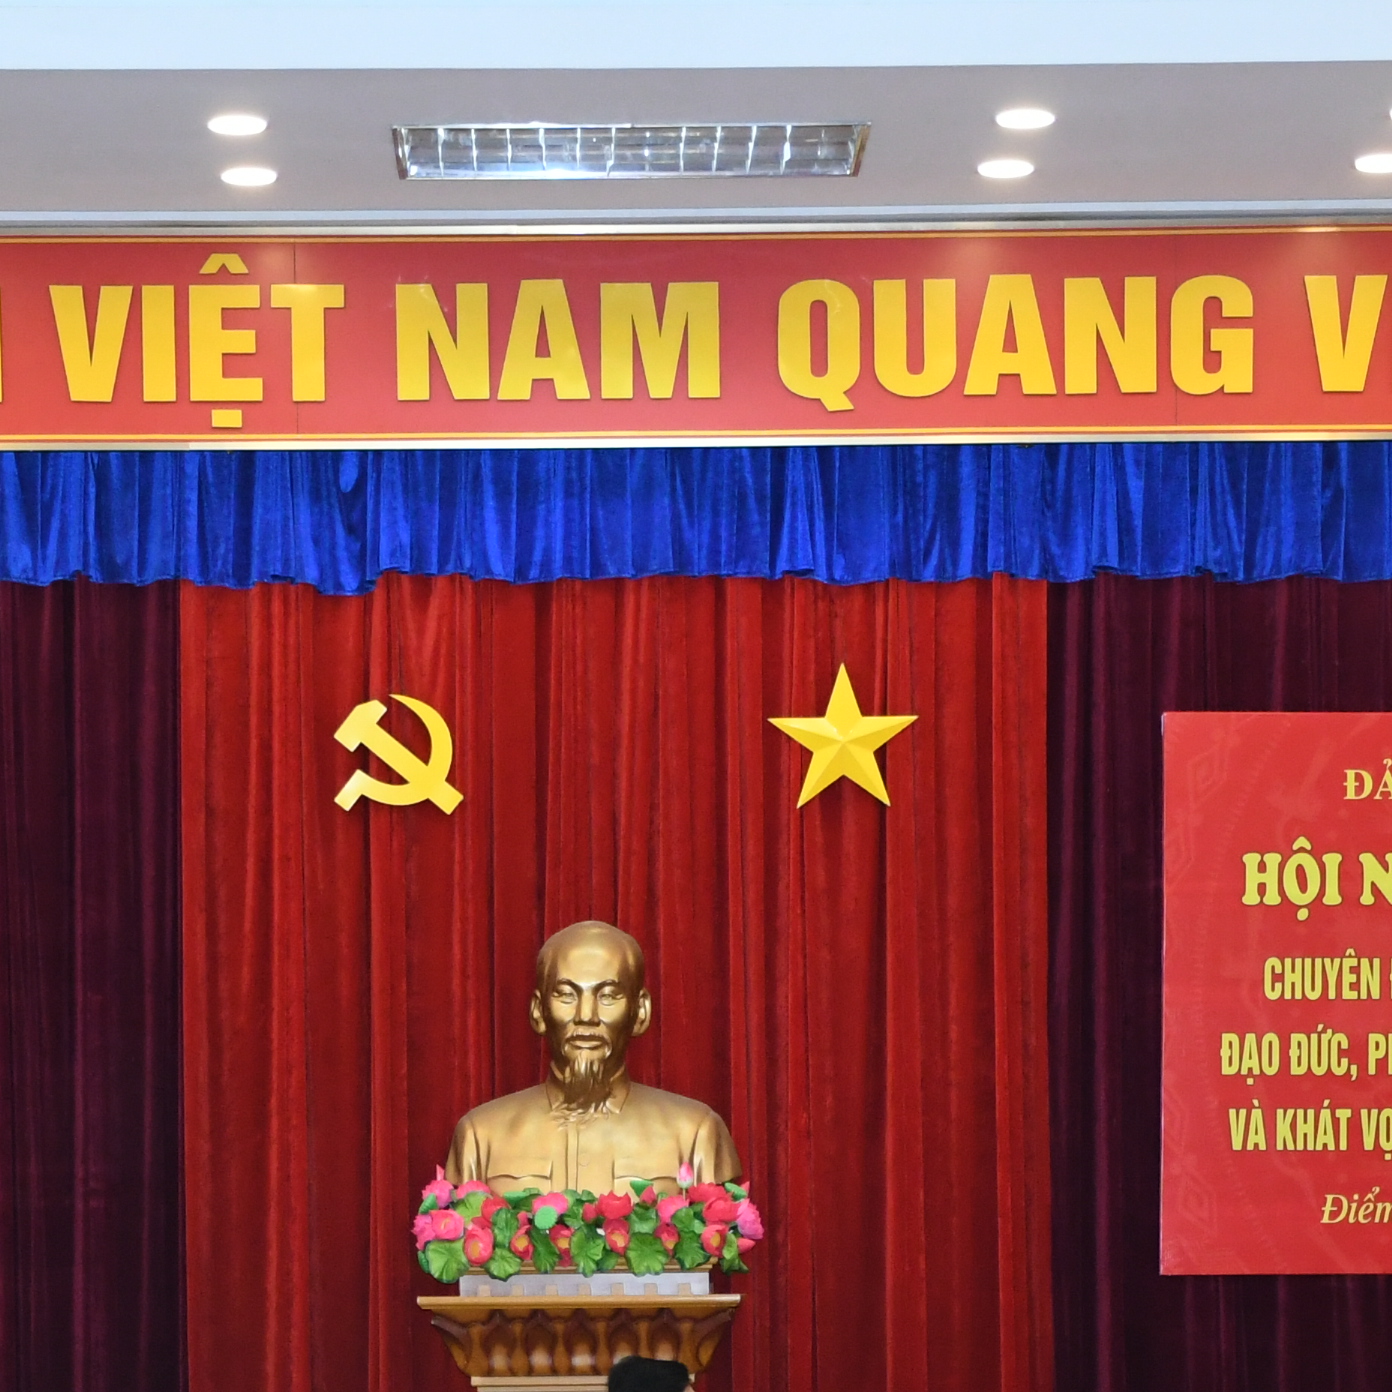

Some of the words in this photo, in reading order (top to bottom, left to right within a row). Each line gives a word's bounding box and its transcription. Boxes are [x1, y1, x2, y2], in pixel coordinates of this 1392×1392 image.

[49, 253, 345, 428] VIỆT
[396, 279, 721, 401] NAM
[777, 274, 1254, 412] QUANG
[1242, 837, 1342, 920] HỘI
[1264, 949, 1380, 1000] CHUYÊN
[1220, 1033, 1279, 1085] ĐẠO
[1289, 1024, 1357, 1080] ĐỨC,
[1229, 1099, 1266, 1150] VÀ
[1277, 1100, 1351, 1150] KHÁT
